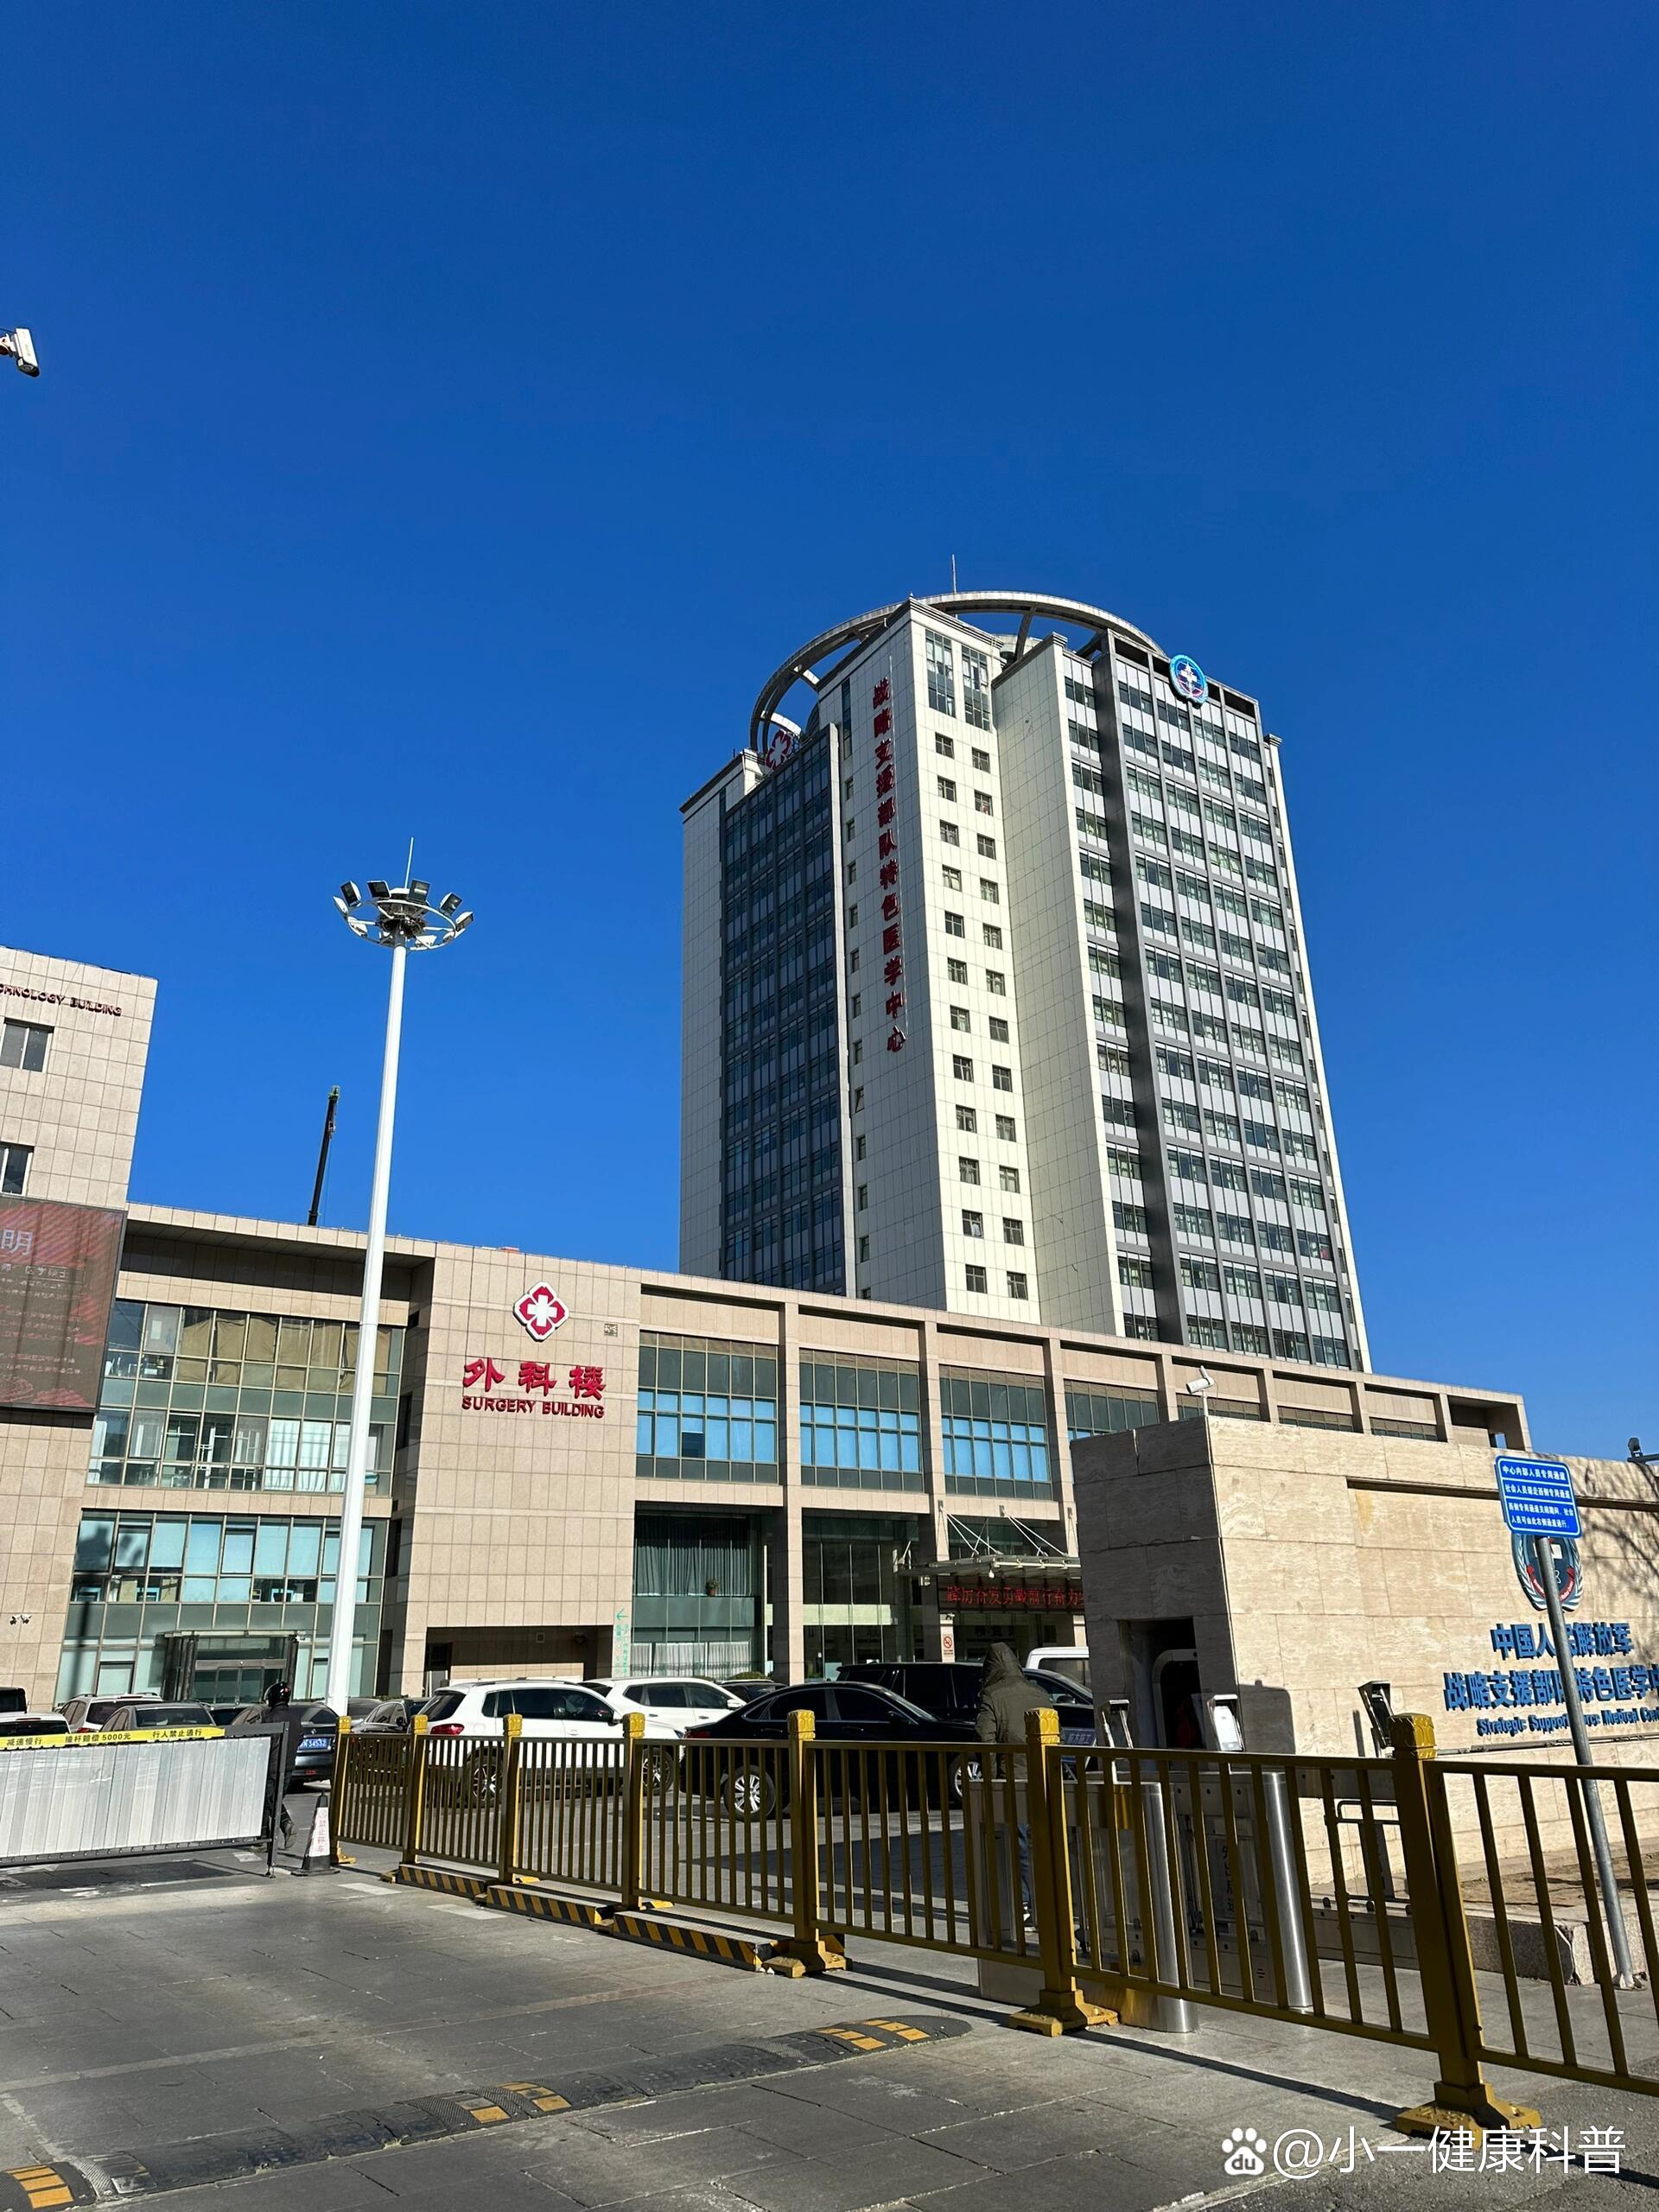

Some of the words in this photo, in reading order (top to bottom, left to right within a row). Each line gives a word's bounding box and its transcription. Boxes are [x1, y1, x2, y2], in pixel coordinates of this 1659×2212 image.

[873, 677, 906, 1053] 战略支援部队特色医学中心
[69, 996, 122, 1016] BUILDING
[462, 1357, 606, 1401] 外科楼
[461, 1395, 537, 1414] SURGERY
[542, 1402, 606, 1419] BUILDING
[152, 1728, 203, 1738] 行人禁止通行
[1477, 1716, 1528, 1737] Strategic
[1601, 1708, 1640, 1726] Medical
